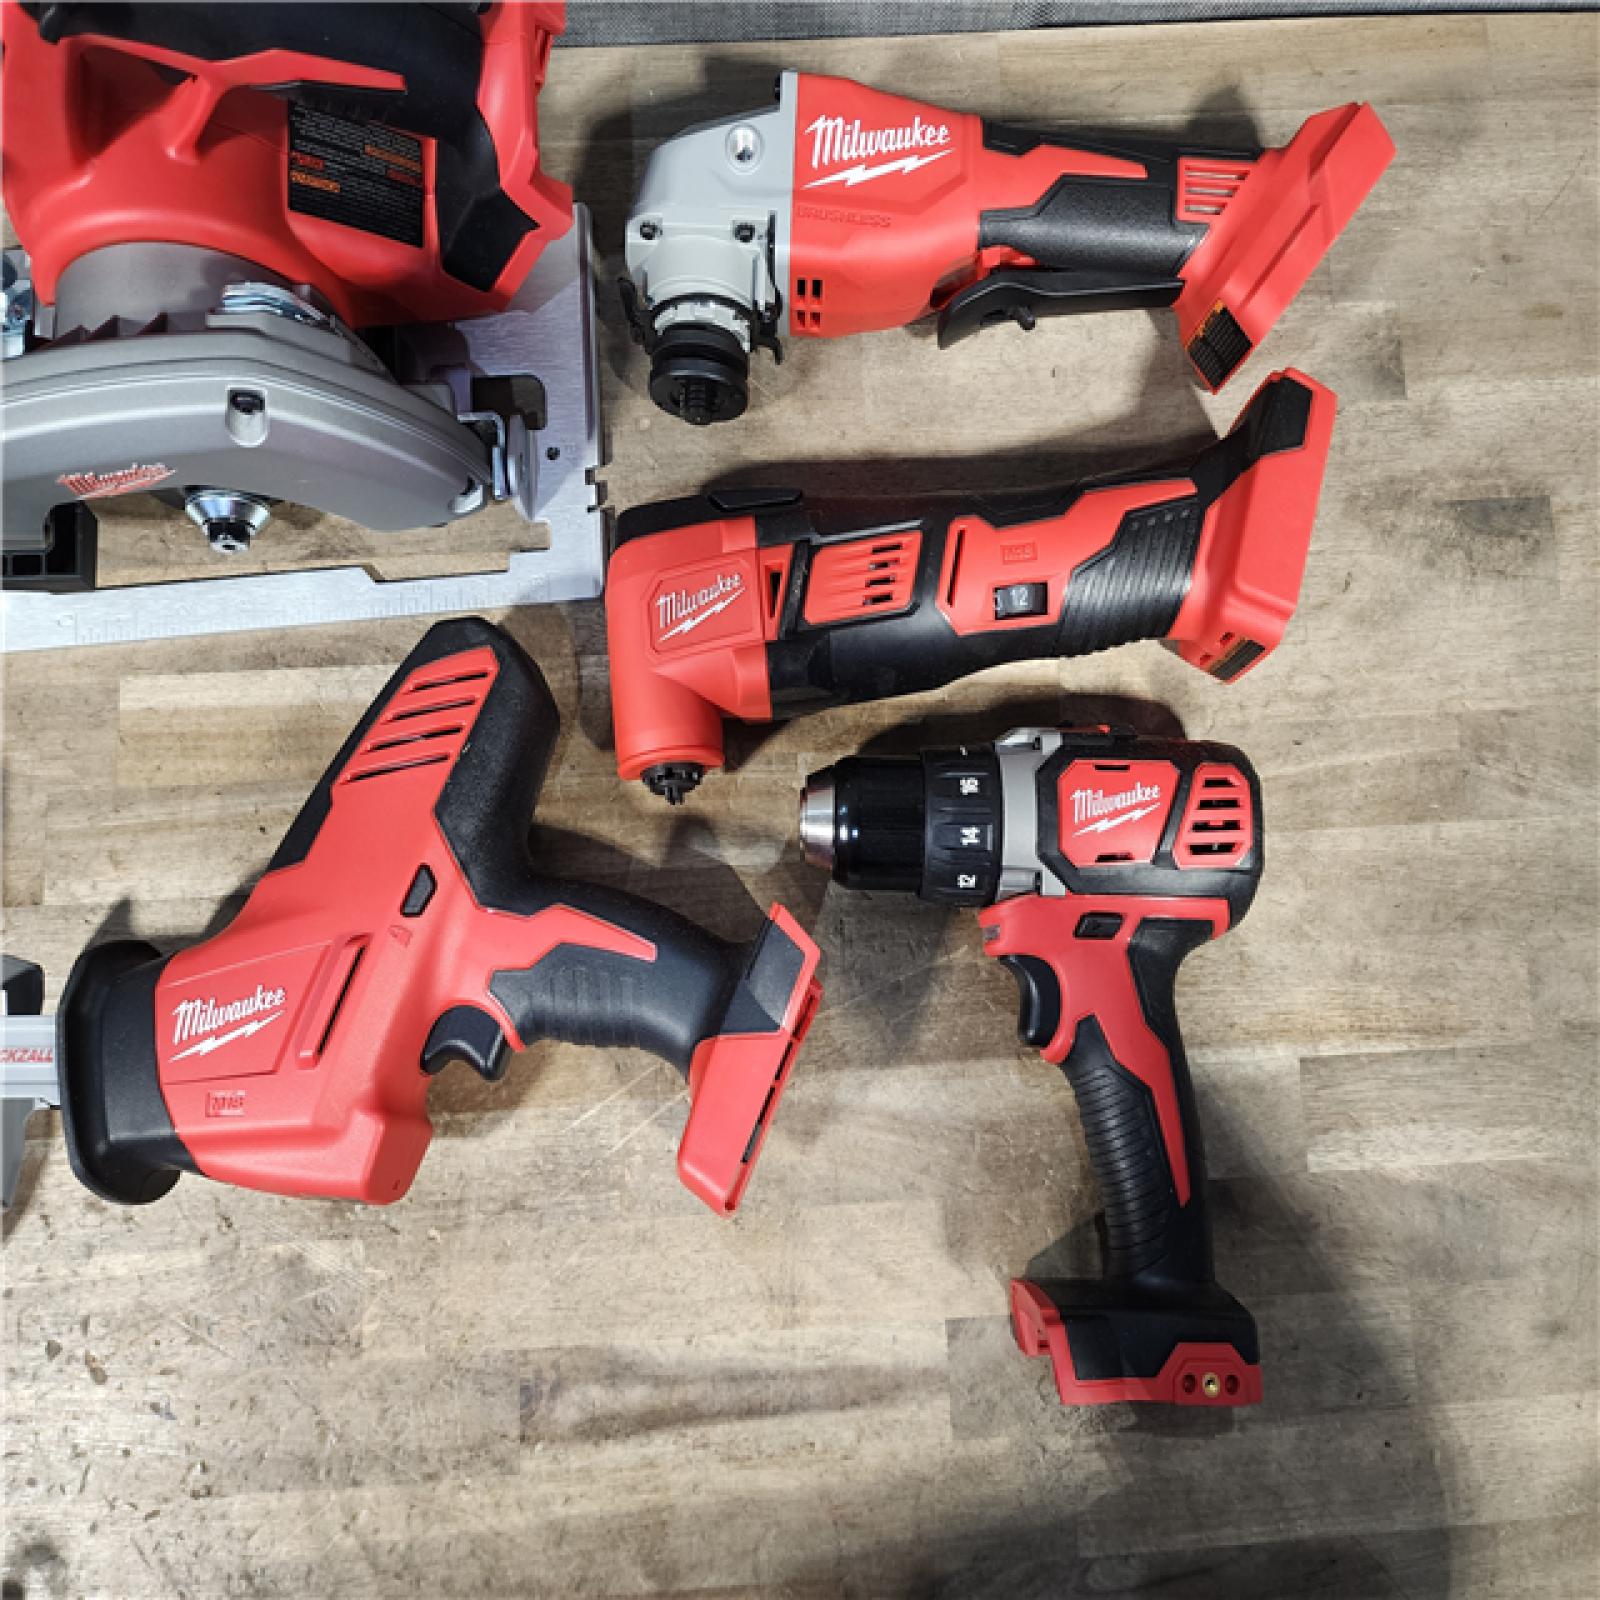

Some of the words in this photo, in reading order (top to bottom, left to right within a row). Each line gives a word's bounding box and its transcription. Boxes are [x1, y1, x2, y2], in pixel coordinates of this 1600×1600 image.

[804, 114, 950, 171] Milwaukee
[655, 572, 741, 628] Milwaukee
[1070, 782, 1160, 824] Milwaukee
[960, 826, 980, 846] 14
[172, 984, 286, 1046] Milwaukee
